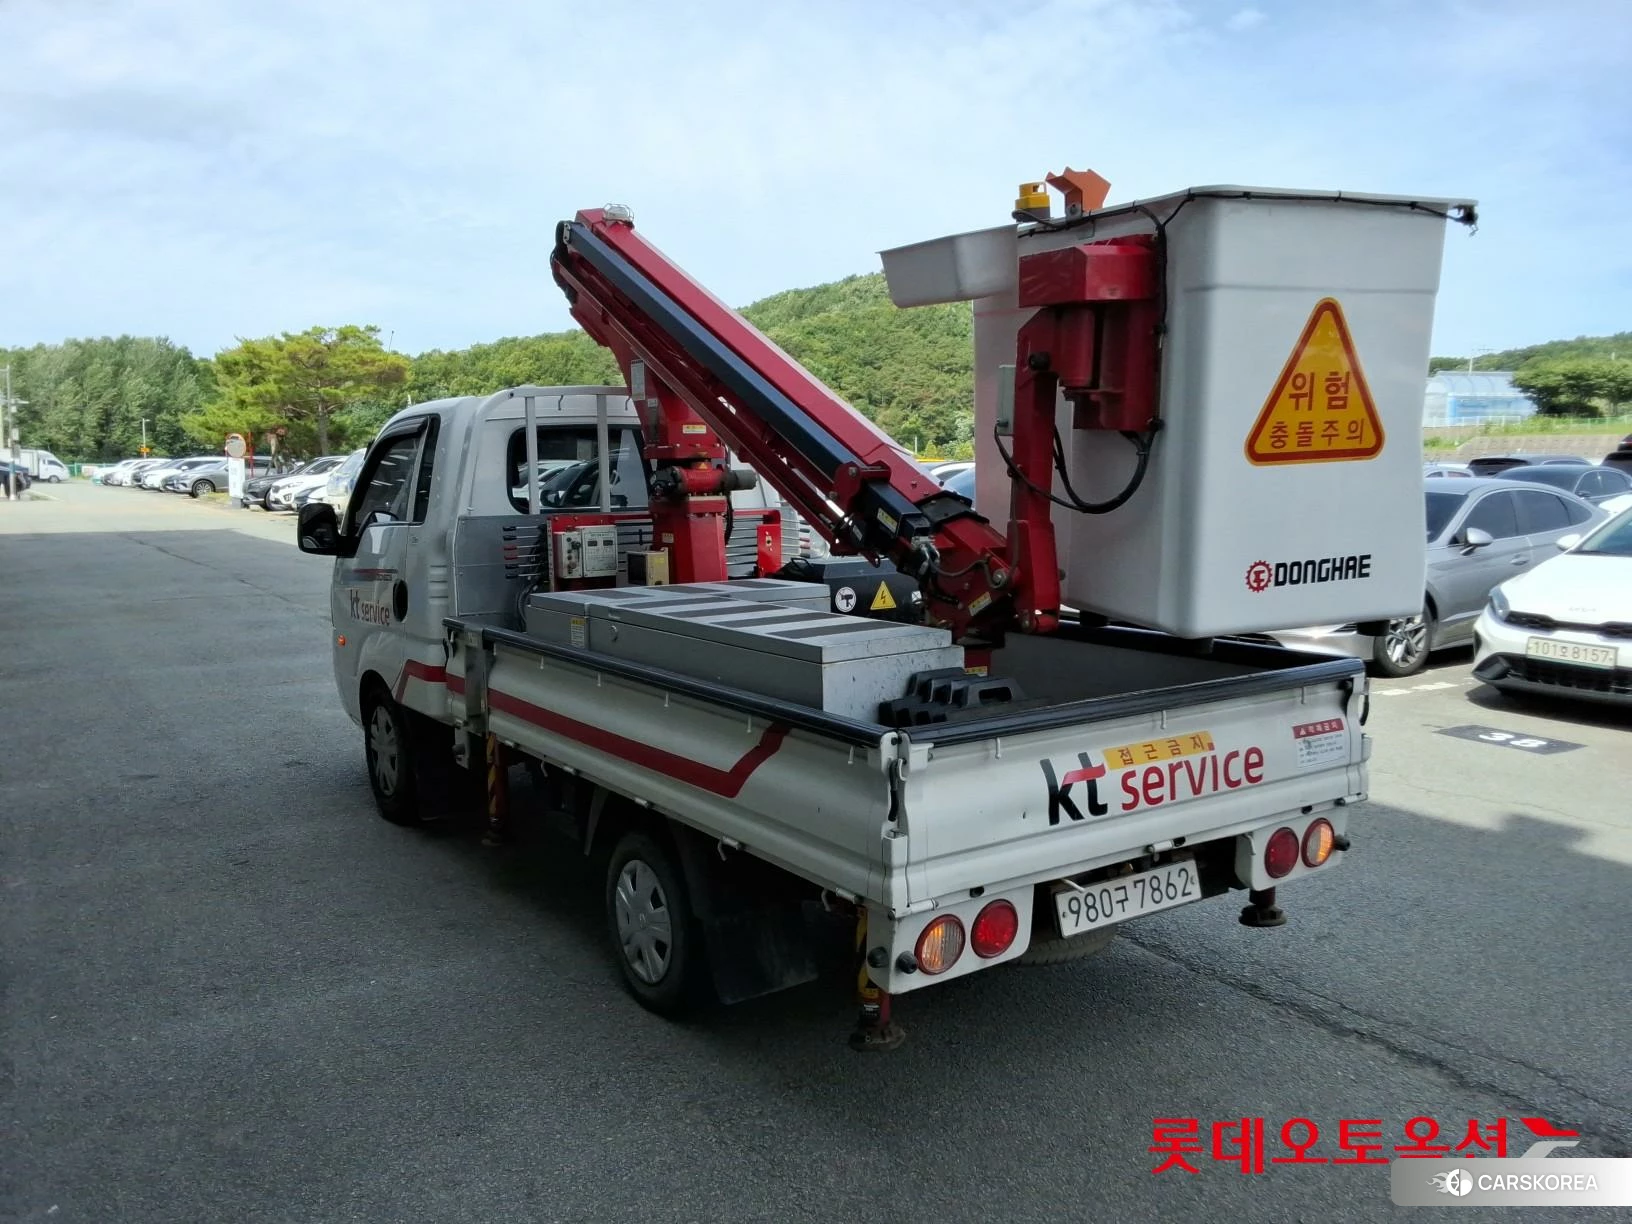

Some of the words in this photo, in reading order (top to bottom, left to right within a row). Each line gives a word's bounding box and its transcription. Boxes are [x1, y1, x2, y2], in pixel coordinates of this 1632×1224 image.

[1288, 371, 1350, 411] 위험
[1269, 418, 1365, 449] 충돌주의
[1274, 554, 1371, 587] DONGHAE
[361, 600, 390, 626] service
[1039, 751, 1108, 826] kt
[1121, 742, 1264, 811] service
